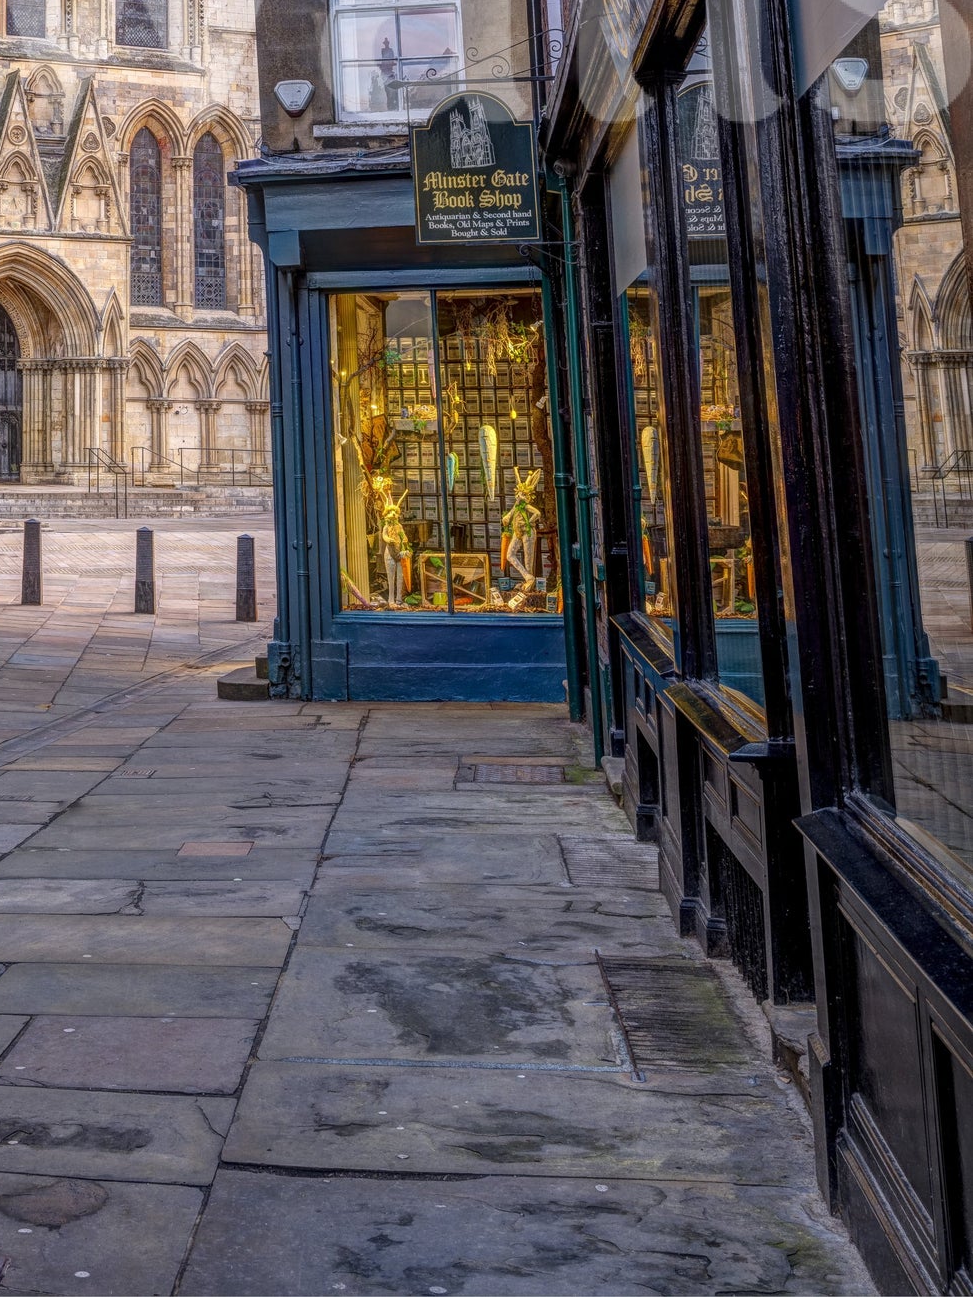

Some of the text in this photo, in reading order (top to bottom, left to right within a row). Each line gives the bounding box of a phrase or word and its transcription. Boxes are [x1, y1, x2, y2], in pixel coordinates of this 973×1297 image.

[423, 169, 529, 191] Minster Gate
[432, 189, 522, 211] Book Shop
[425, 209, 532, 222] Antiquarian & Second hand
[428, 219, 530, 230] Books, Old Maps & Prints
[451, 227, 508, 239] Bought & Sold
